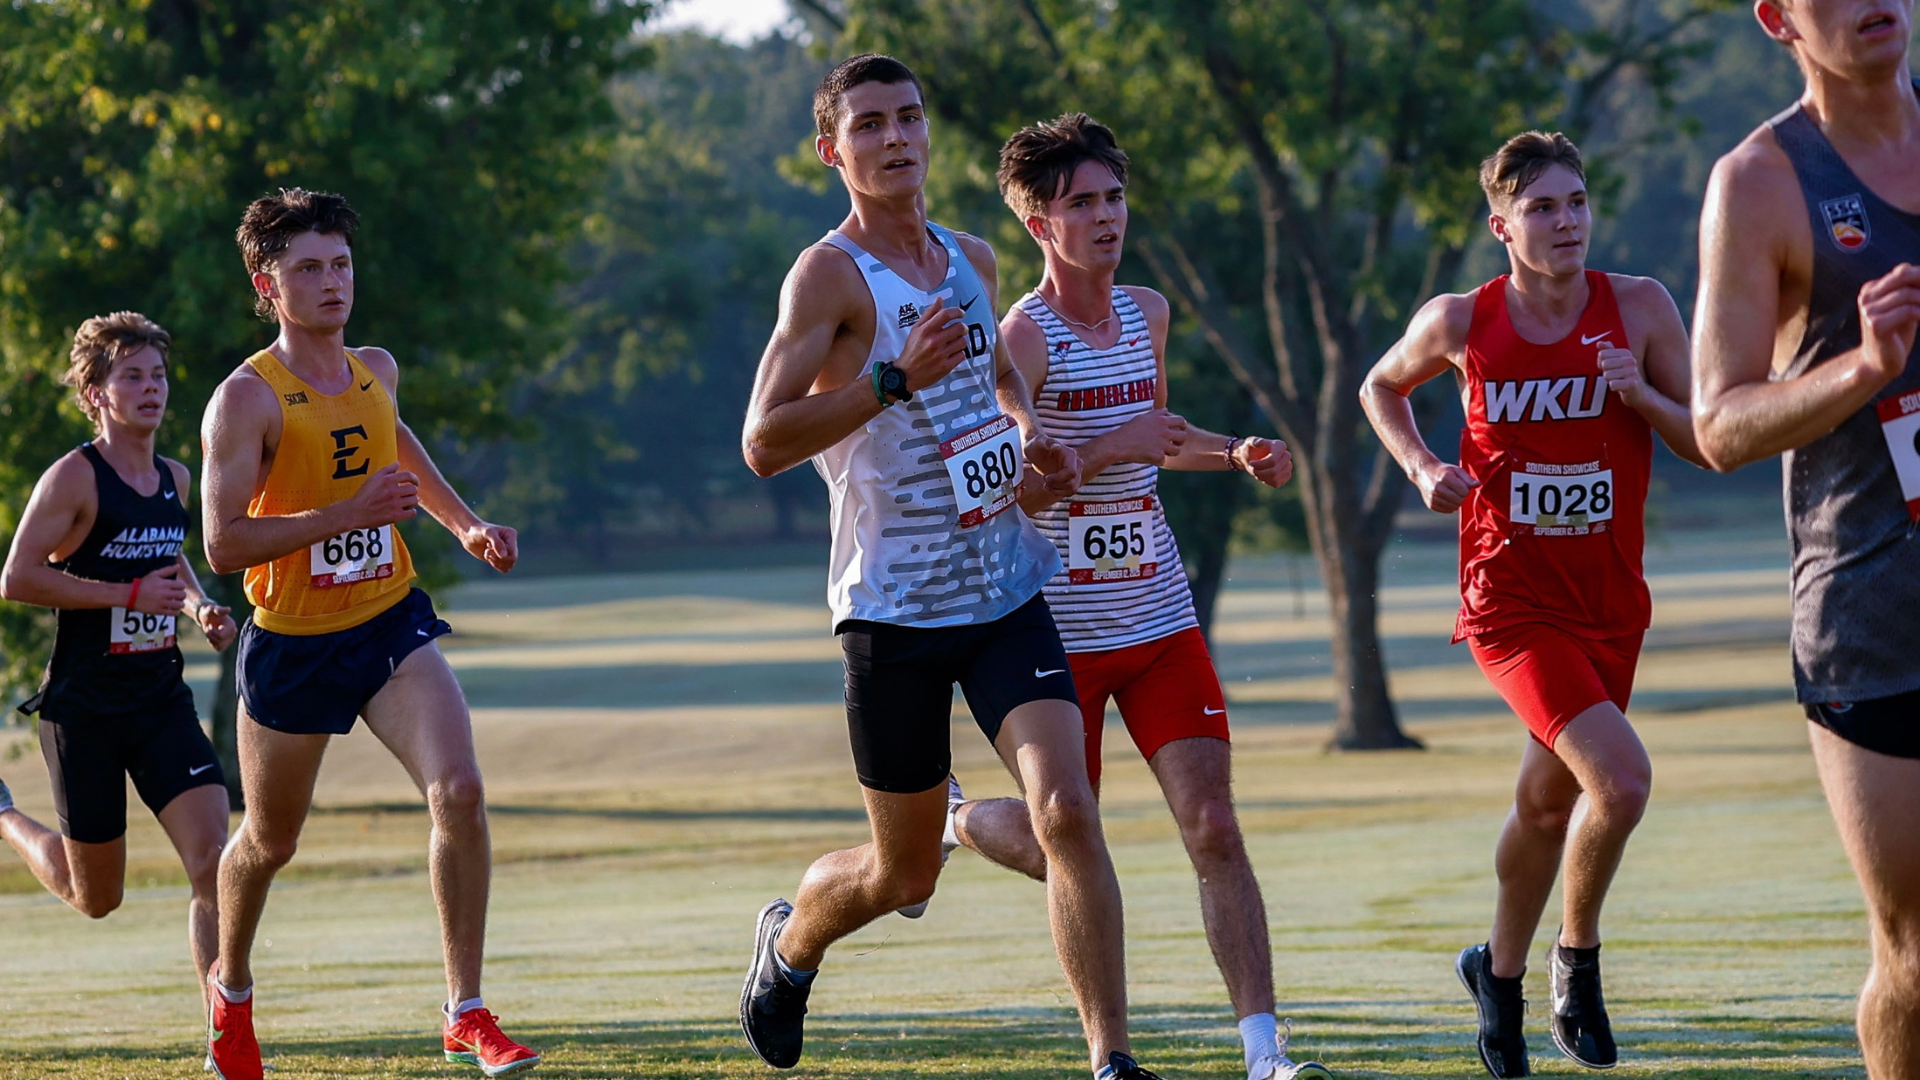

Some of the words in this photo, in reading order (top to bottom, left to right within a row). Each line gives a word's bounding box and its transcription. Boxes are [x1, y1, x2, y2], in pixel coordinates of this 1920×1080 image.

[963, 323, 987, 359] D
[1484, 375, 1608, 423] WKU
[330, 424, 370, 480] E
[950, 430, 982, 453] SOUTHERN
[980, 416, 1010, 441] SHOWCASE
[962, 442, 1017, 499] 880
[1526, 462, 1562, 474] SOUTHERN
[1563, 460, 1600, 474] SHOWCASE
[1083, 503, 1118, 515] SOUTHERN
[1118, 499, 1144, 512] SHOWCASE
[1515, 480, 1611, 516] 1028
[100, 543, 183, 559] HUNTSVILL
[112, 526, 185, 543] ALABAMA
[323, 528, 383, 565] 668
[1083, 522, 1145, 560] 655
